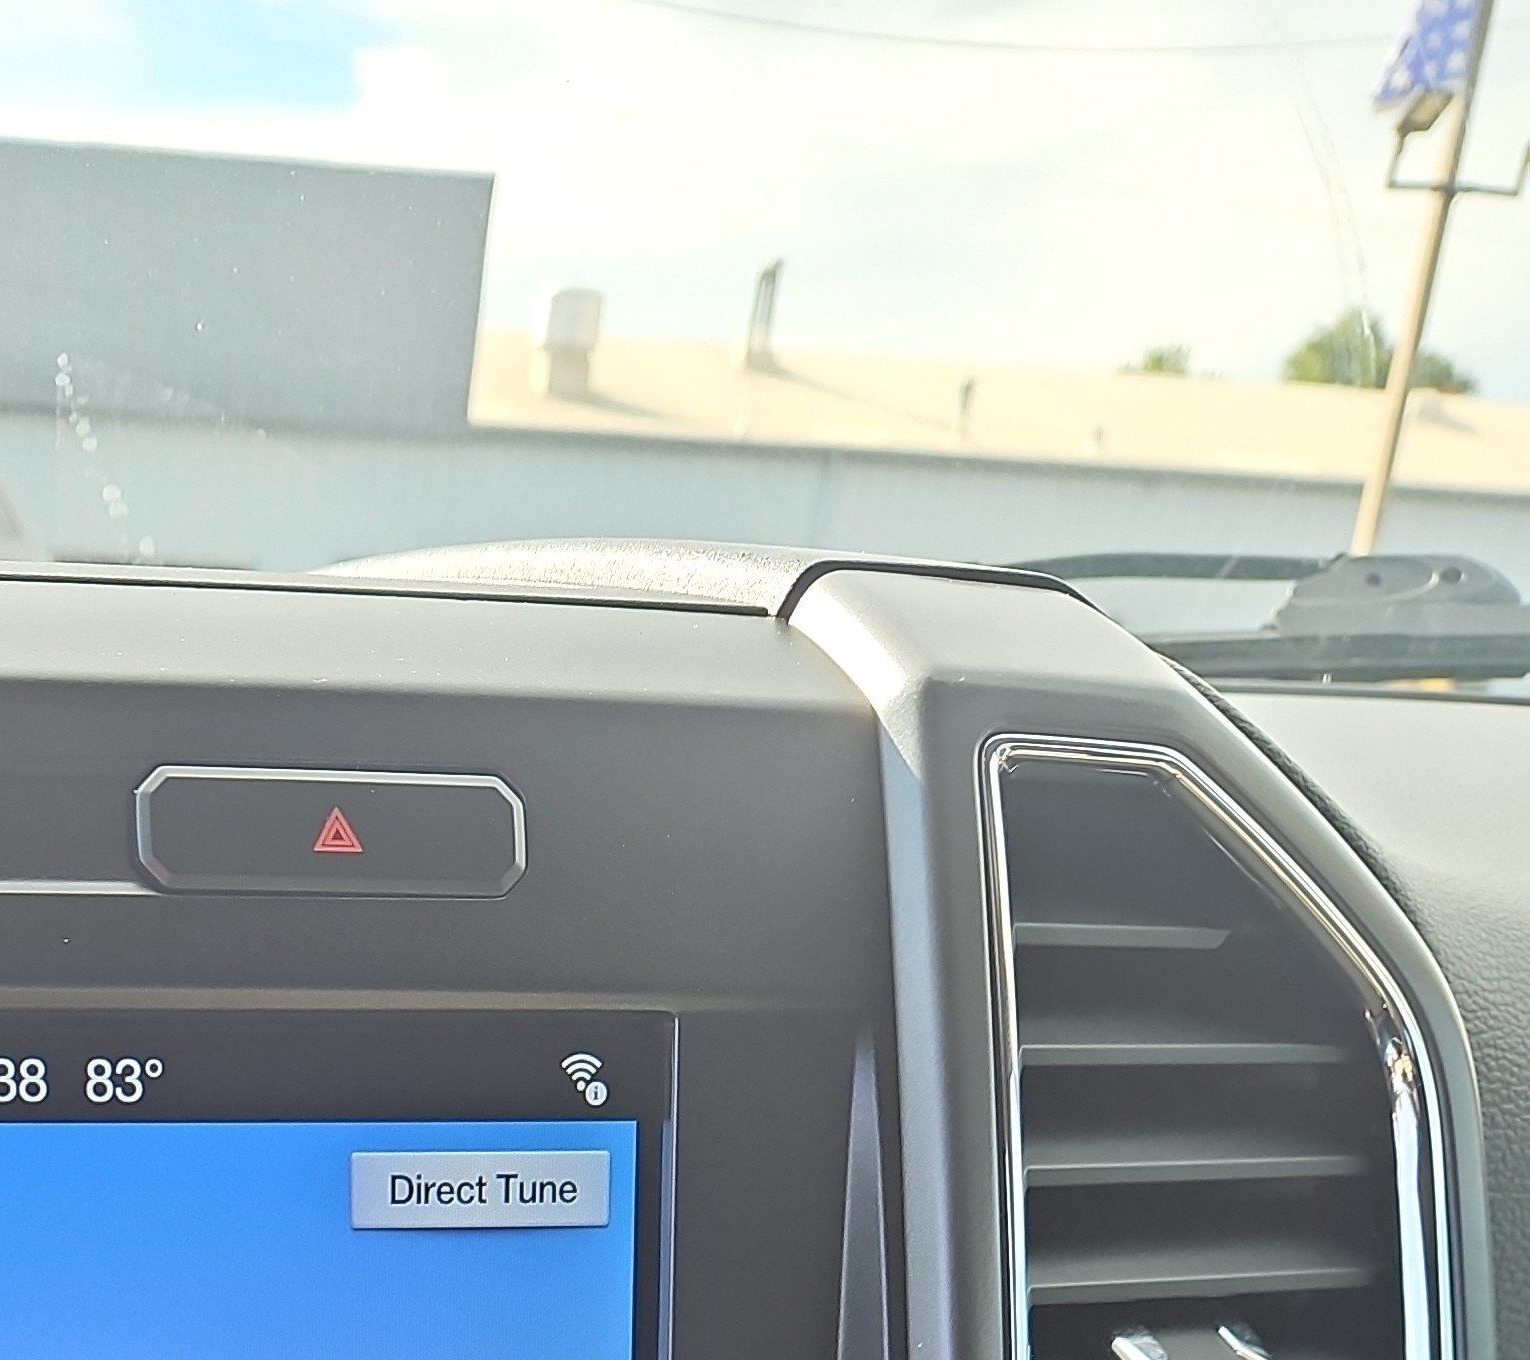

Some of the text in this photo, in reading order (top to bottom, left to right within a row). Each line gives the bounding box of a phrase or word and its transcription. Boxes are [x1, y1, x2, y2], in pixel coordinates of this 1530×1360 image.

[85, 1057, 164, 1103] 83°
[389, 1174, 578, 1205] Direct Tune
